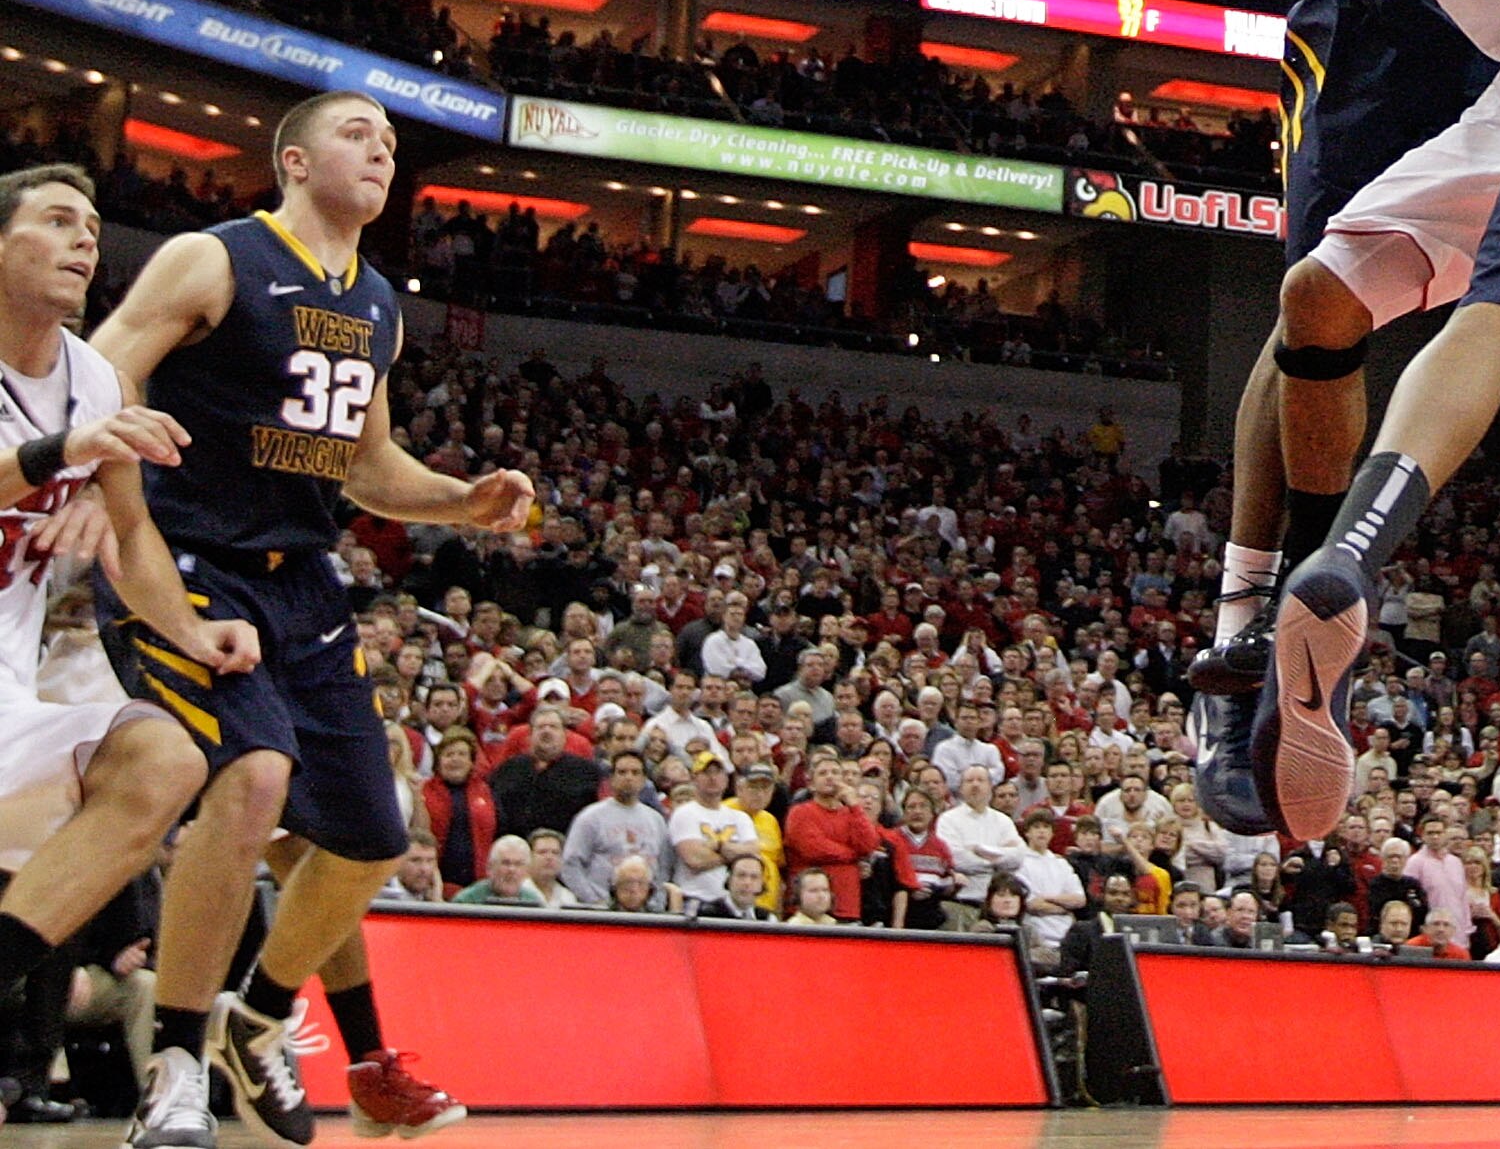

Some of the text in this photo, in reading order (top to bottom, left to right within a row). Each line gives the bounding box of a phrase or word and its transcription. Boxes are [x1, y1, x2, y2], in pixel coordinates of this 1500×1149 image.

[198, 16, 344, 75] BUD LIGHT
[365, 68, 498, 124] BUD LIGHT
[524, 102, 543, 132] NU
[616, 119, 681, 140] Glacier
[688, 128, 722, 147] Dry
[831, 146, 875, 165] FREE
[880, 153, 949, 177] Pick-Up
[955, 161, 968, 177] &
[974, 165, 1054, 190] Delivery!
[293, 305, 375, 357] WEST
[280, 348, 376, 438] 32
